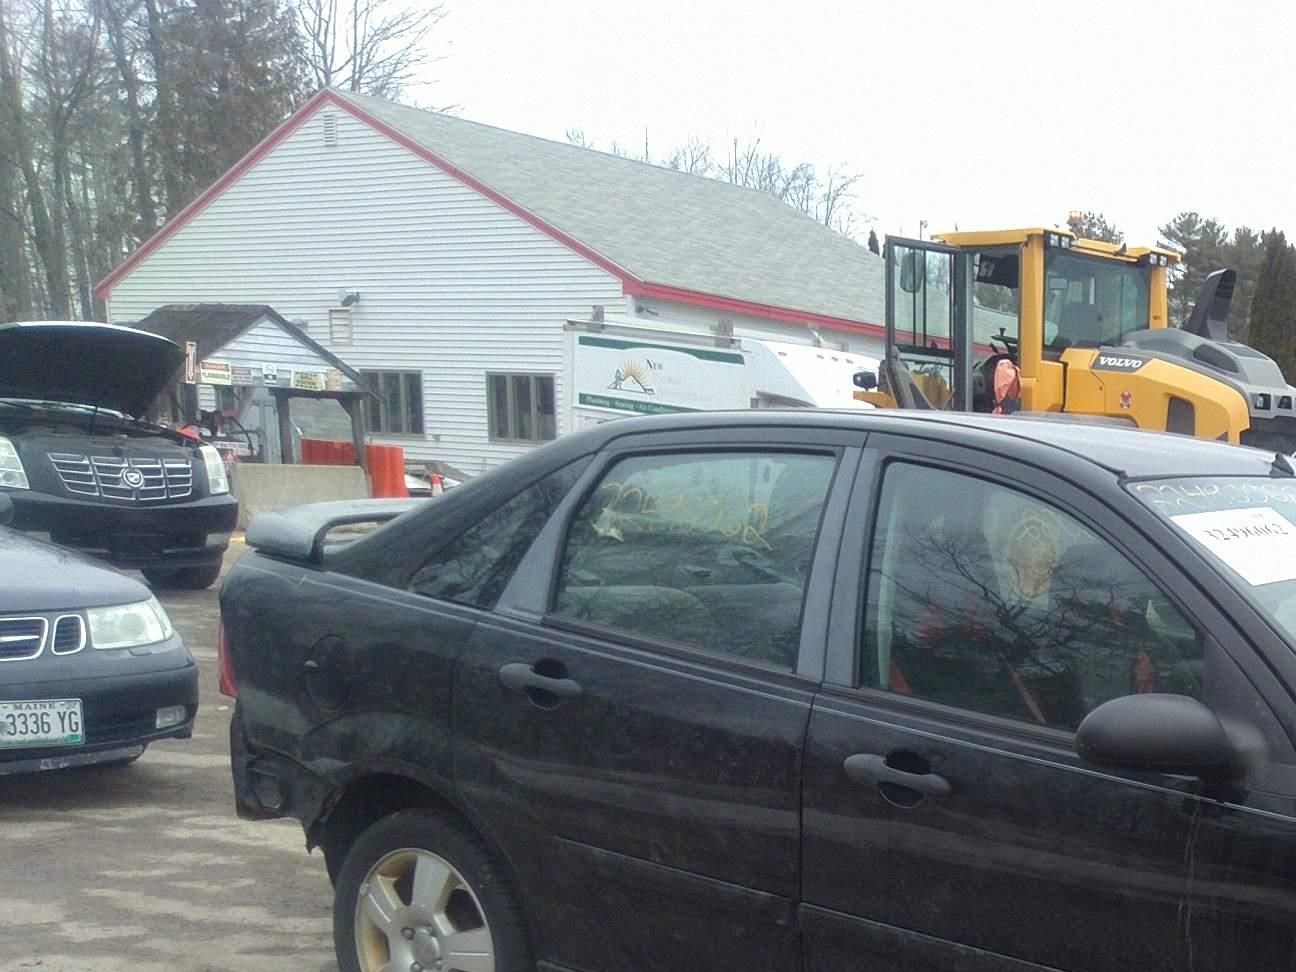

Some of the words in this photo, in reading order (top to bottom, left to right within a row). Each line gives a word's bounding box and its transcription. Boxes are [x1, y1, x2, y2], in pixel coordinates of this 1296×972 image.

[1099, 356, 1143, 368] VOLVO
[13, 702, 56, 711] MAINE
[6, 711, 52, 736] 3336
[57, 710, 79, 734] YG
